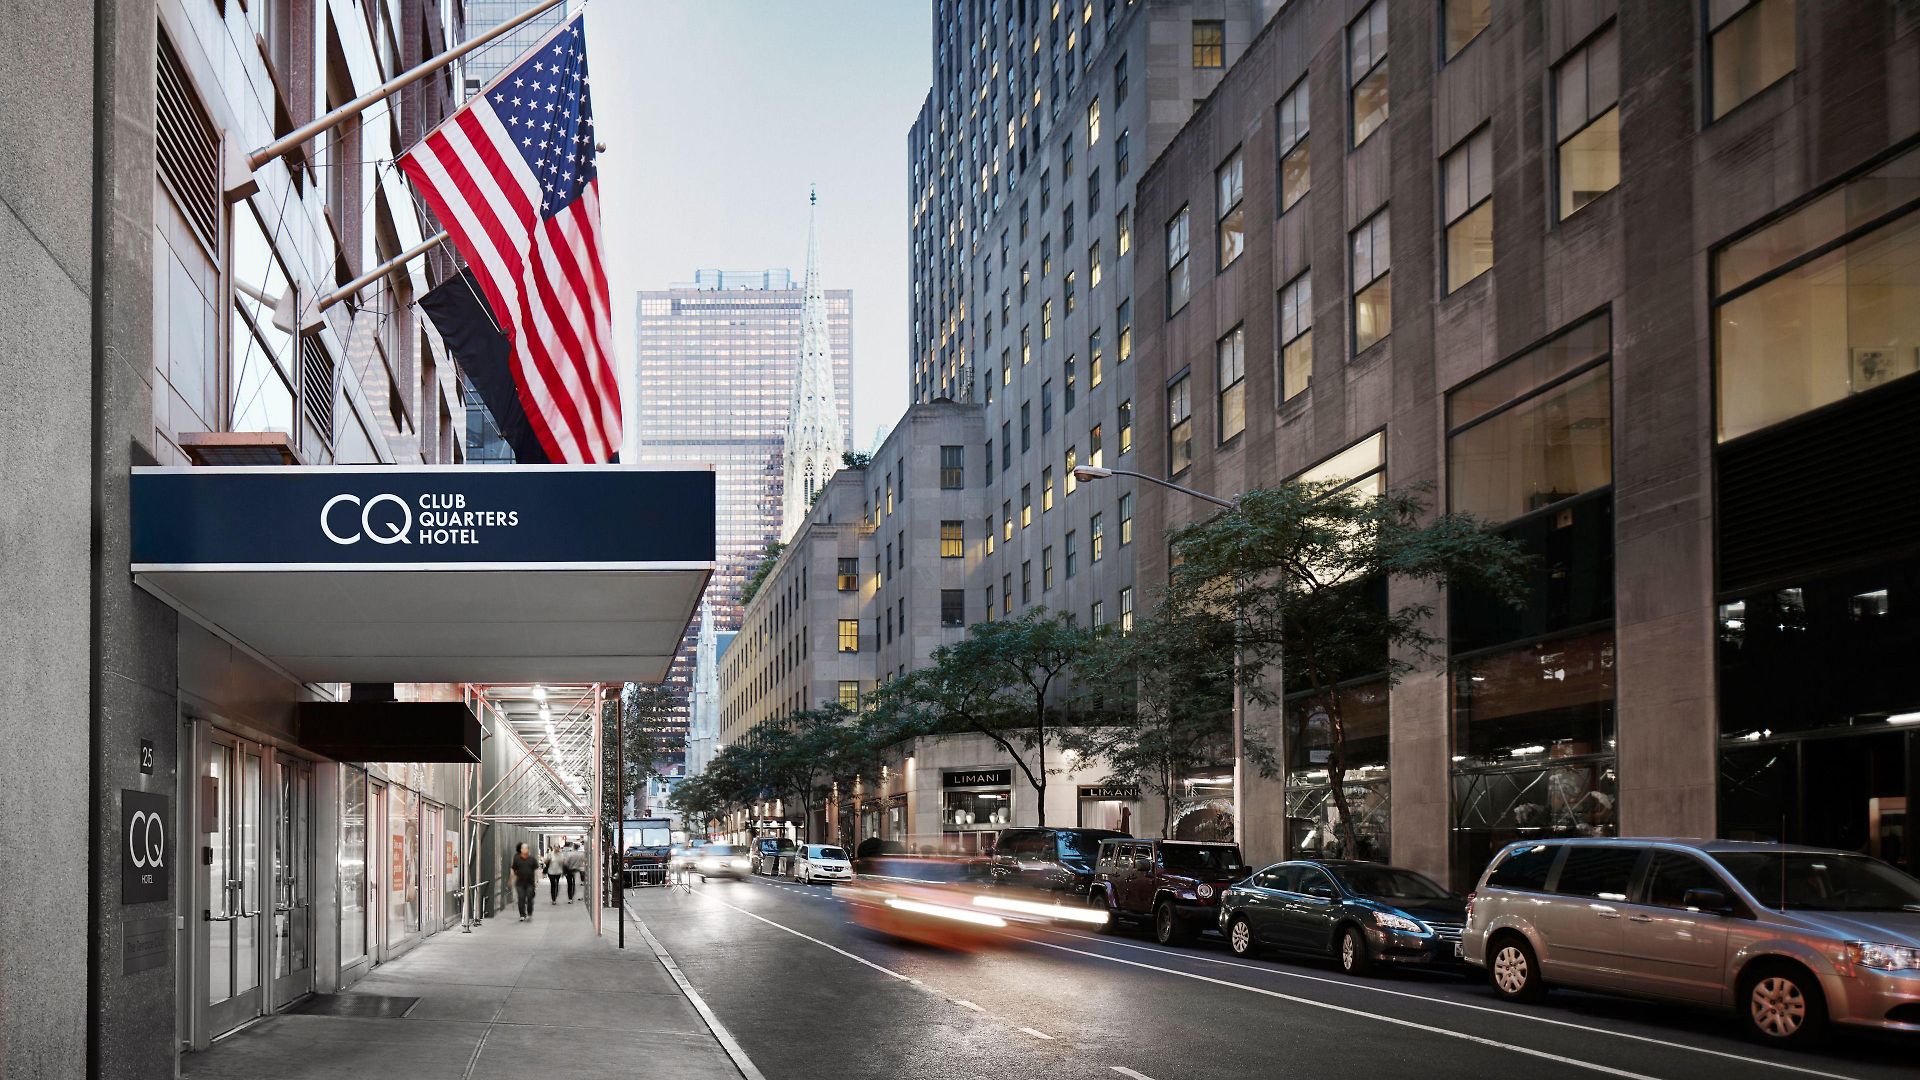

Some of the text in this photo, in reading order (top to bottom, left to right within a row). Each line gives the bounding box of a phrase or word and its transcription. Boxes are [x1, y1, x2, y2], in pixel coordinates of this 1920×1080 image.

[419, 494, 466, 509] CLUB
[321, 493, 412, 545] CQ
[419, 510, 519, 527] QUARTERS
[419, 529, 479, 544] HOTEL
[142, 746, 153, 768] 25
[953, 773, 1000, 784] LIMANI
[1090, 788, 1137, 797] LIMANI
[129, 810, 164, 868] CQ
[141, 874, 154, 884] HOTEL
